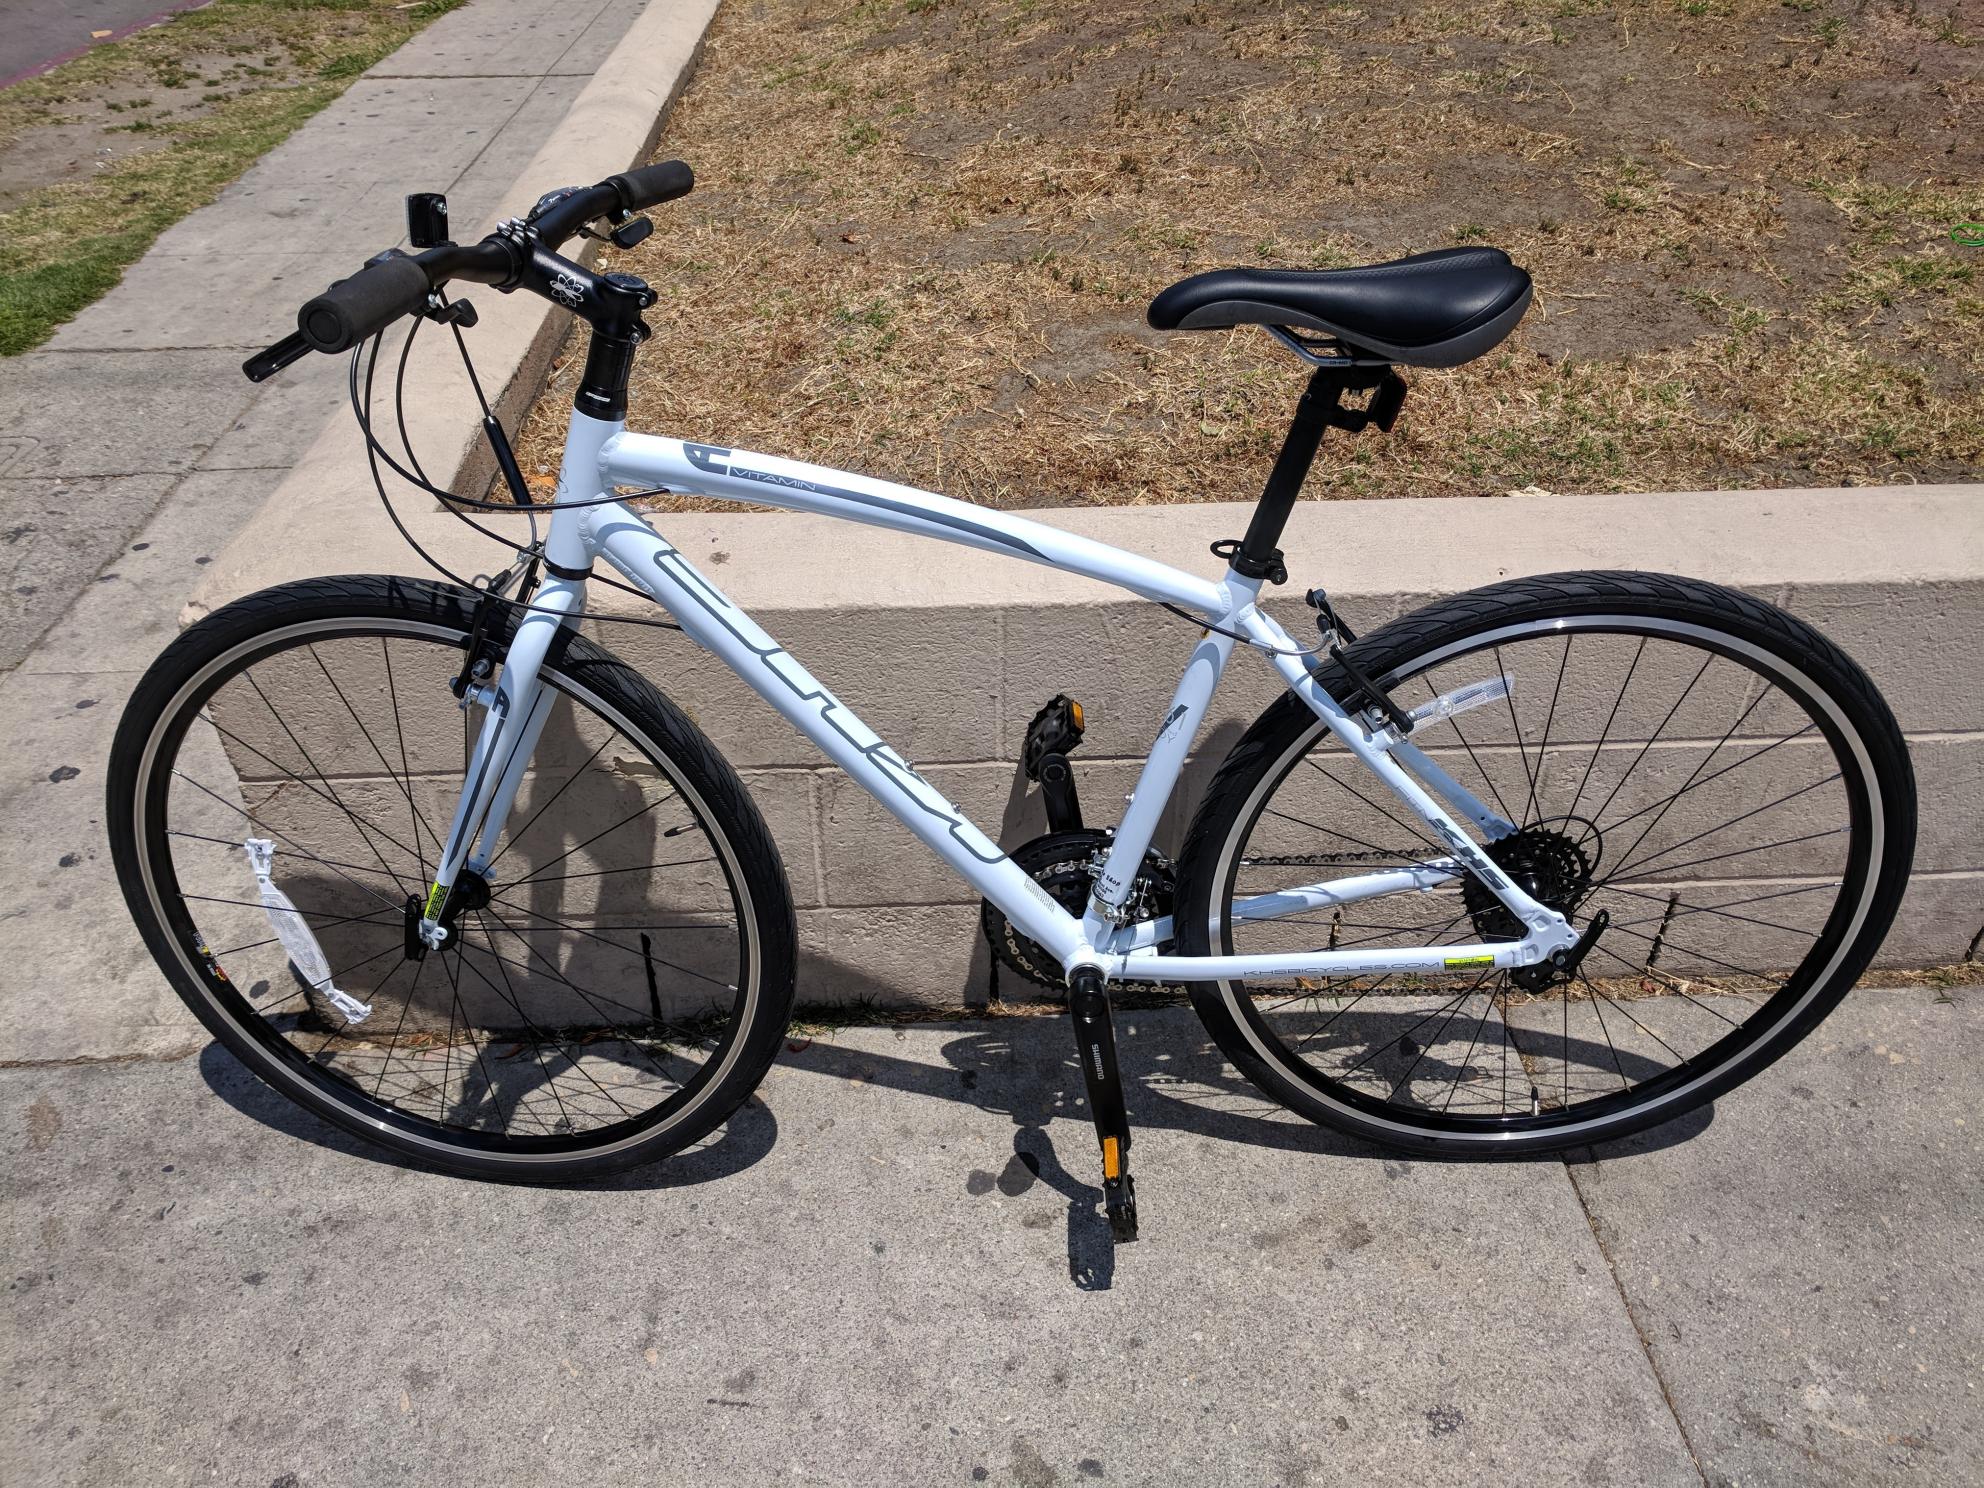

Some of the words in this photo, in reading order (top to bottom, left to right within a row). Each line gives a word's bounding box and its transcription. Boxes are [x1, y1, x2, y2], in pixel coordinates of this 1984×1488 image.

[732, 467, 817, 491] VITAMIN
[1243, 962, 1440, 978] KHSBICYCLES.COM
[1091, 1043, 1105, 1081] SHIMANO
